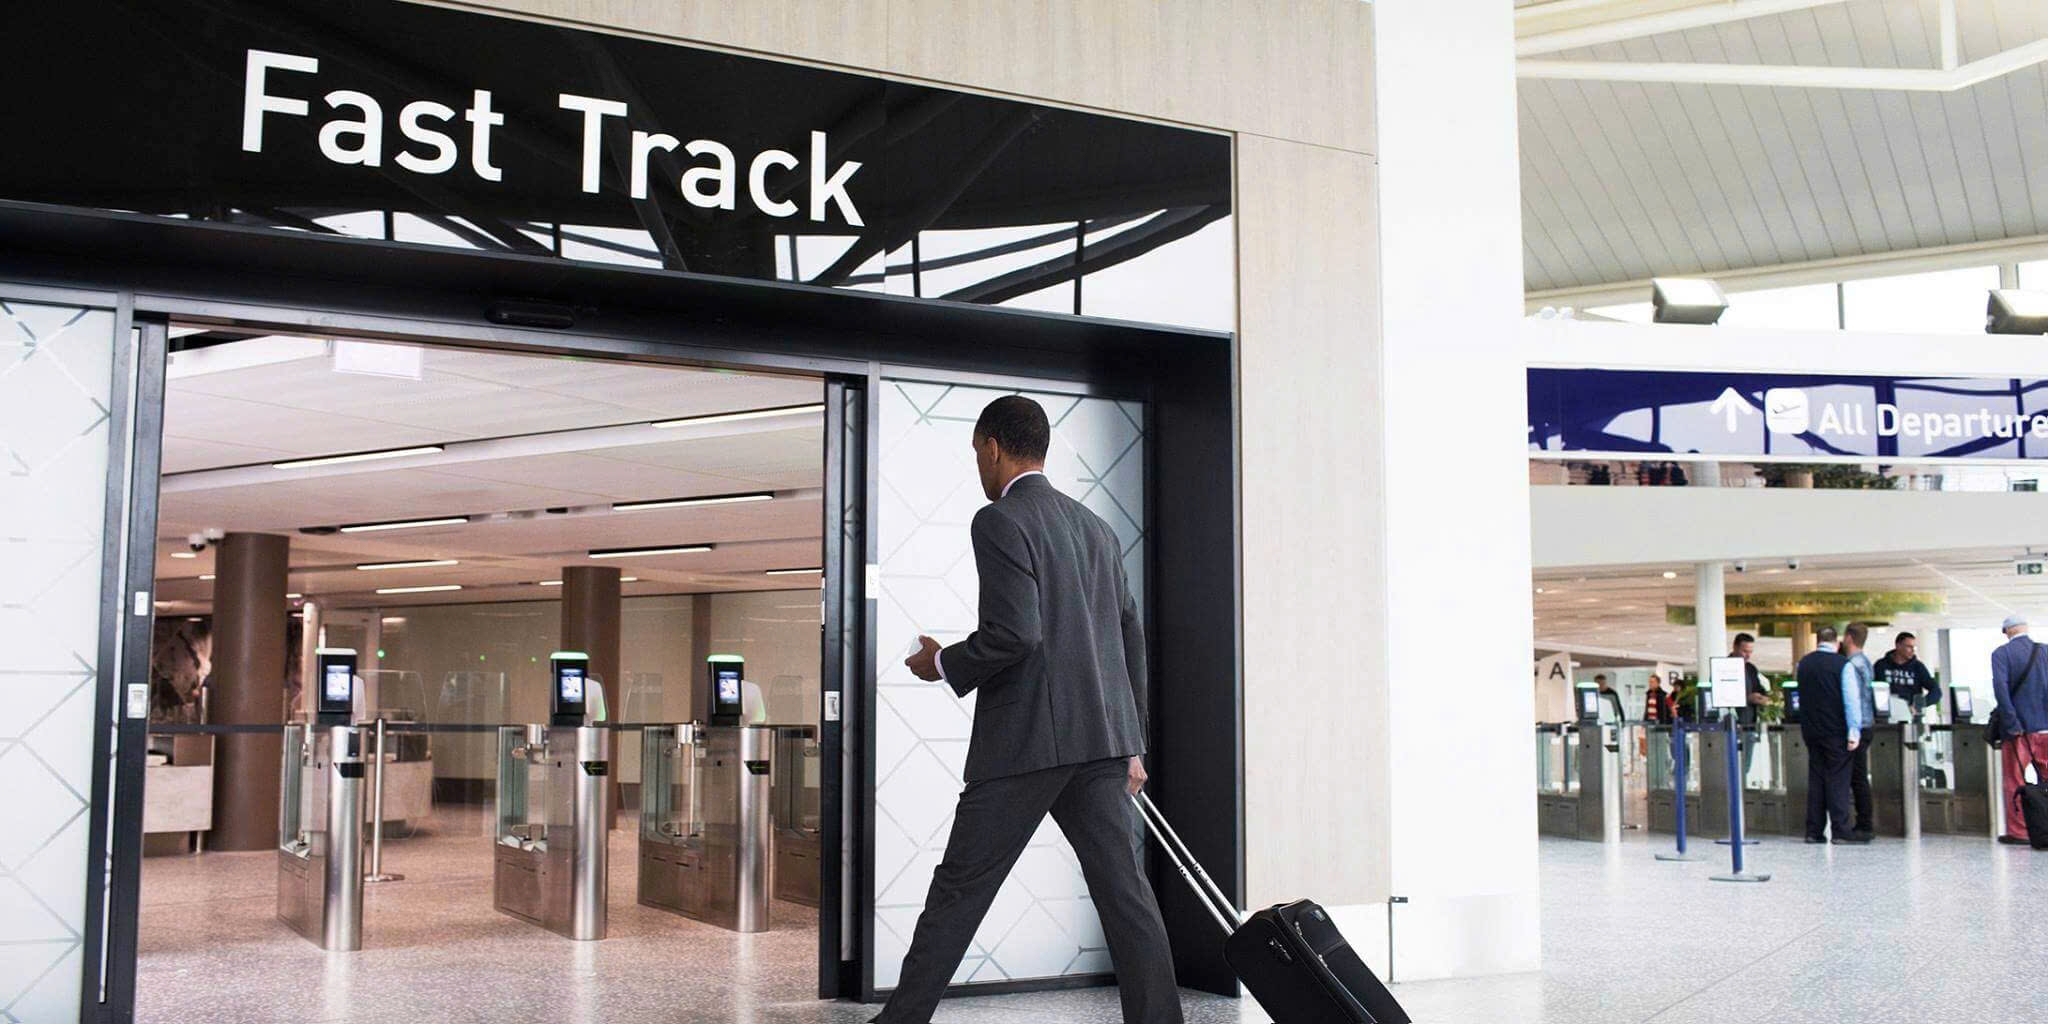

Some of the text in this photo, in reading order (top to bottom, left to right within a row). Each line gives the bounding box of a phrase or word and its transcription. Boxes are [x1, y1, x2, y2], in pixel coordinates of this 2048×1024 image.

[241, 48, 865, 227] Fast Track
[1818, 402, 2048, 445] All Departure
[1549, 661, 1566, 680] A
